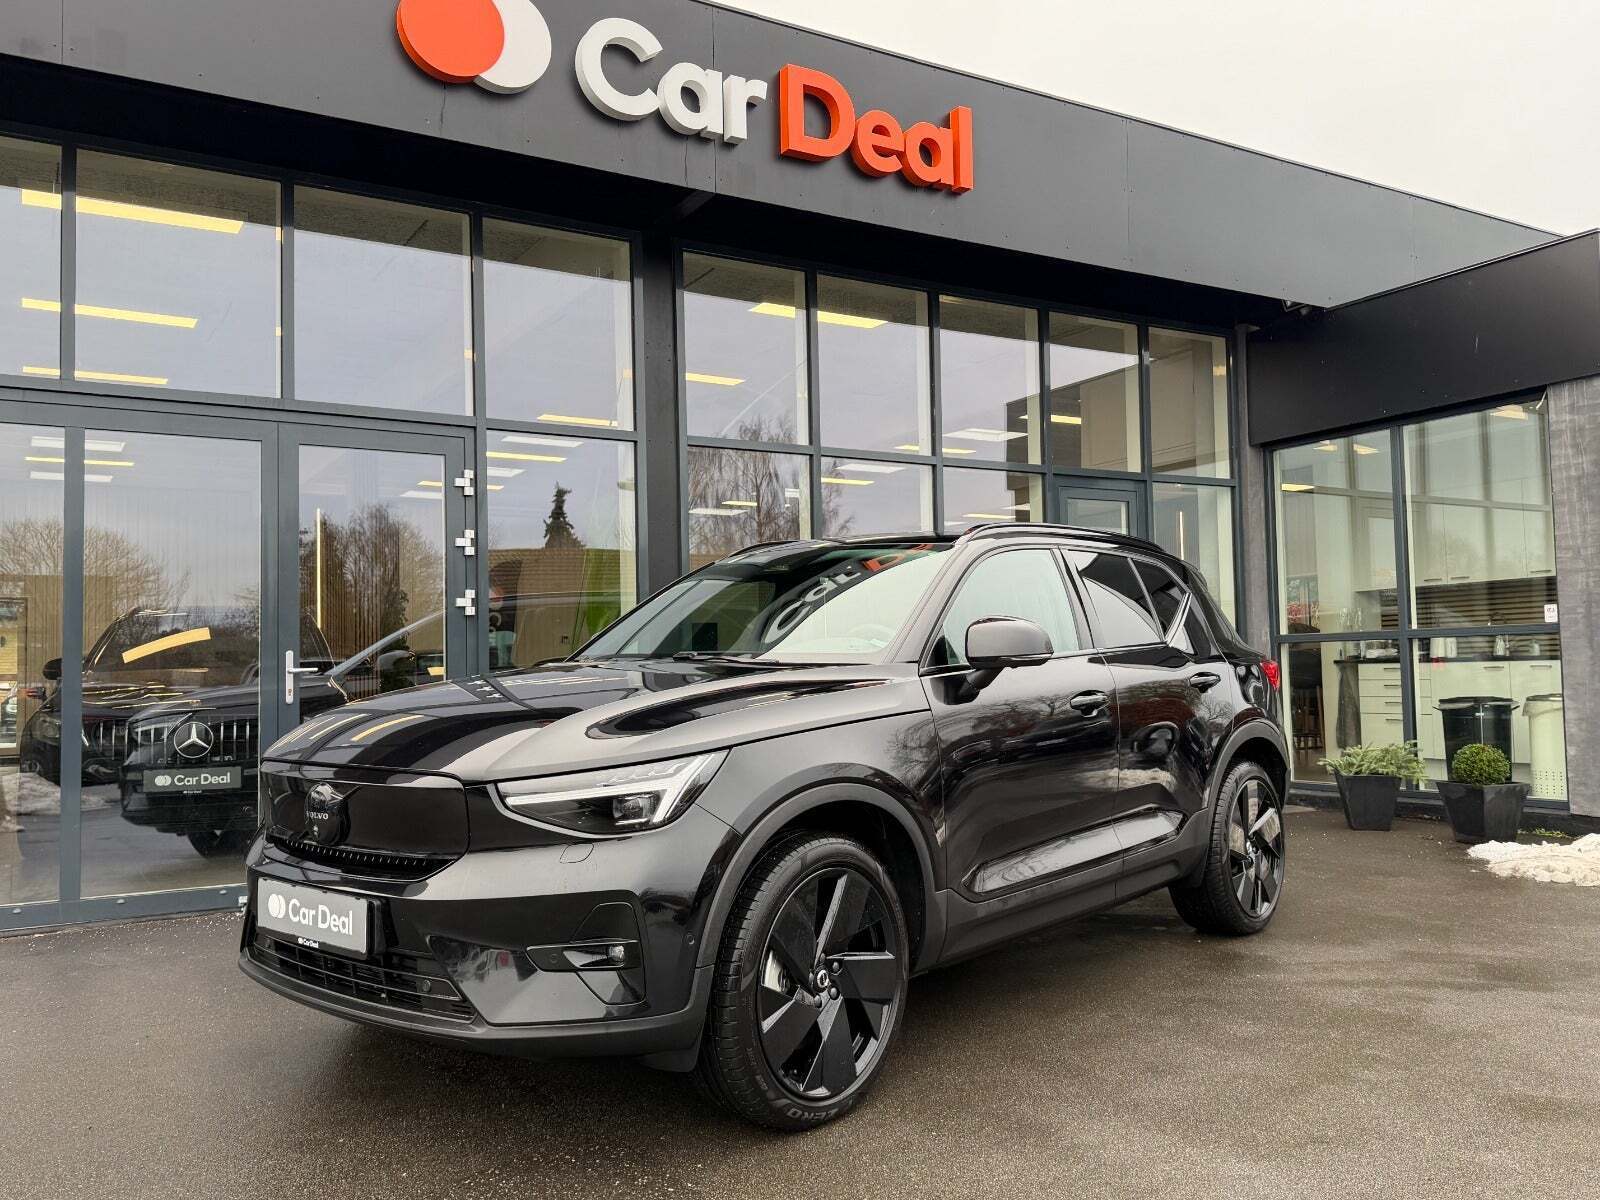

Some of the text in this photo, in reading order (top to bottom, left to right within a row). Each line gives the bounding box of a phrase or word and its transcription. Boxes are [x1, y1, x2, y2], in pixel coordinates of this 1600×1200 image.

[574, 17, 973, 194] Car Deal
[174, 771, 231, 786] Car Deal
[288, 898, 353, 936] Car Deal
